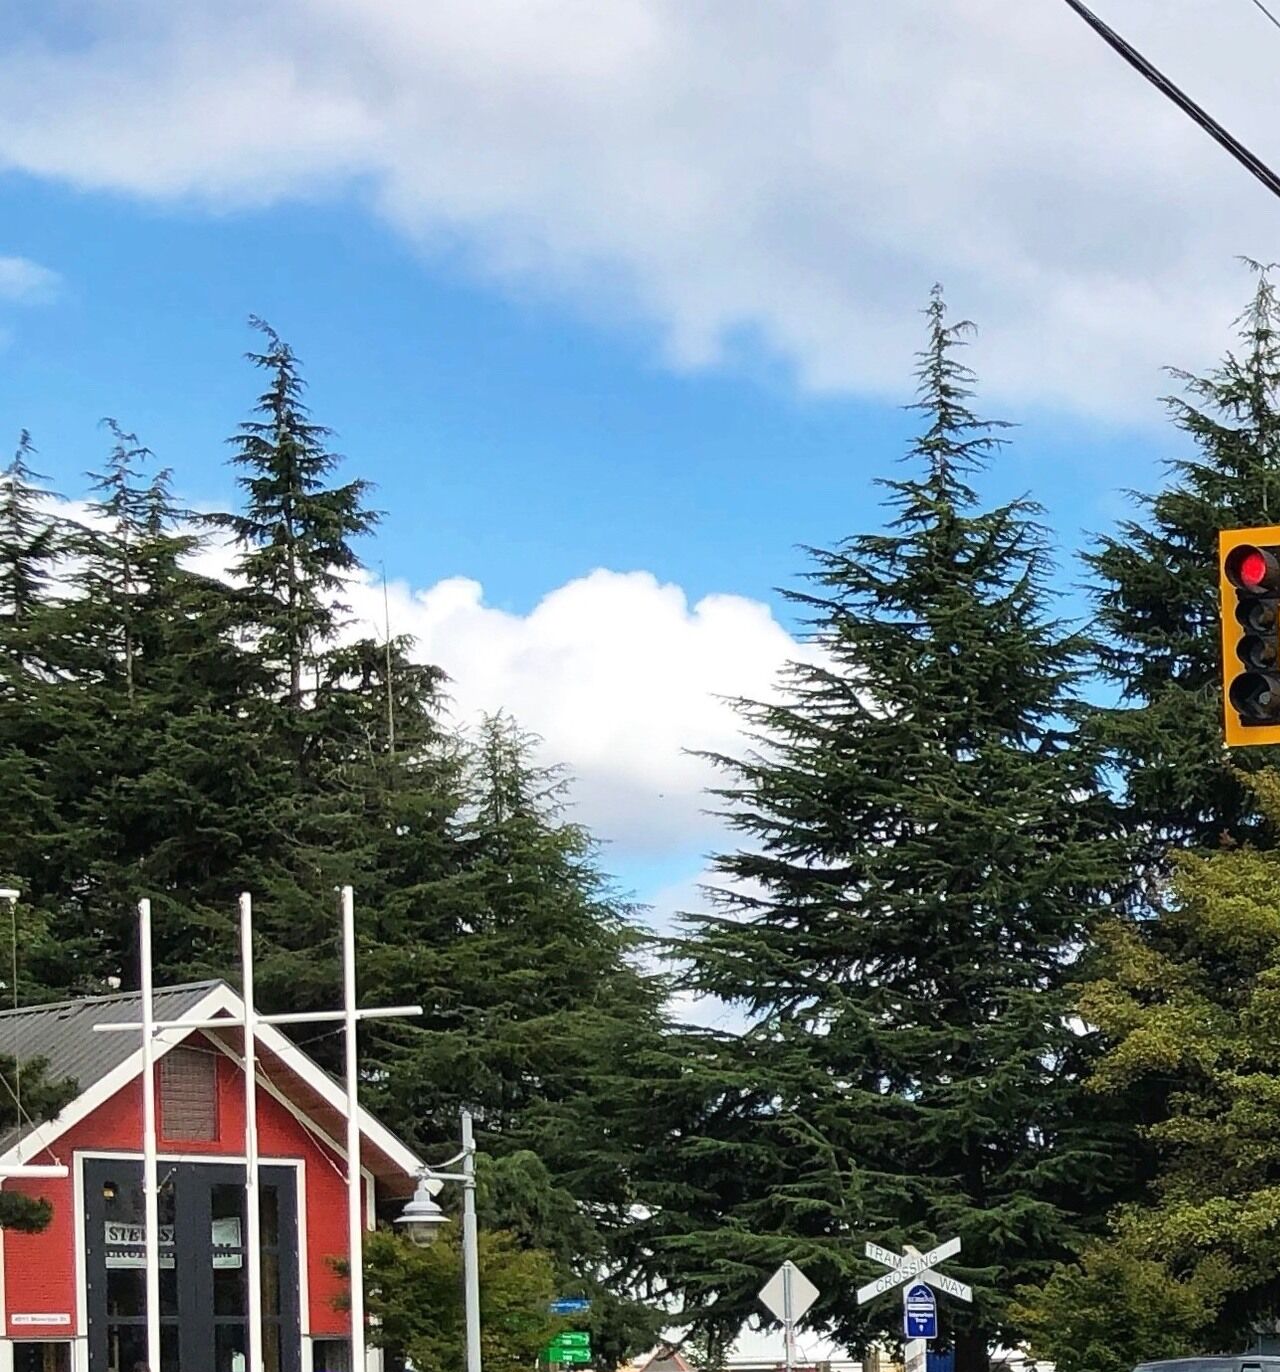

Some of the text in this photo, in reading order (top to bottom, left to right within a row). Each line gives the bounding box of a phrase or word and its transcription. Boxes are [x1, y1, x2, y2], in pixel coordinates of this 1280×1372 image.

[867, 1244, 966, 1296] TRAM WAY
[876, 1251, 938, 1292] CROSSING
